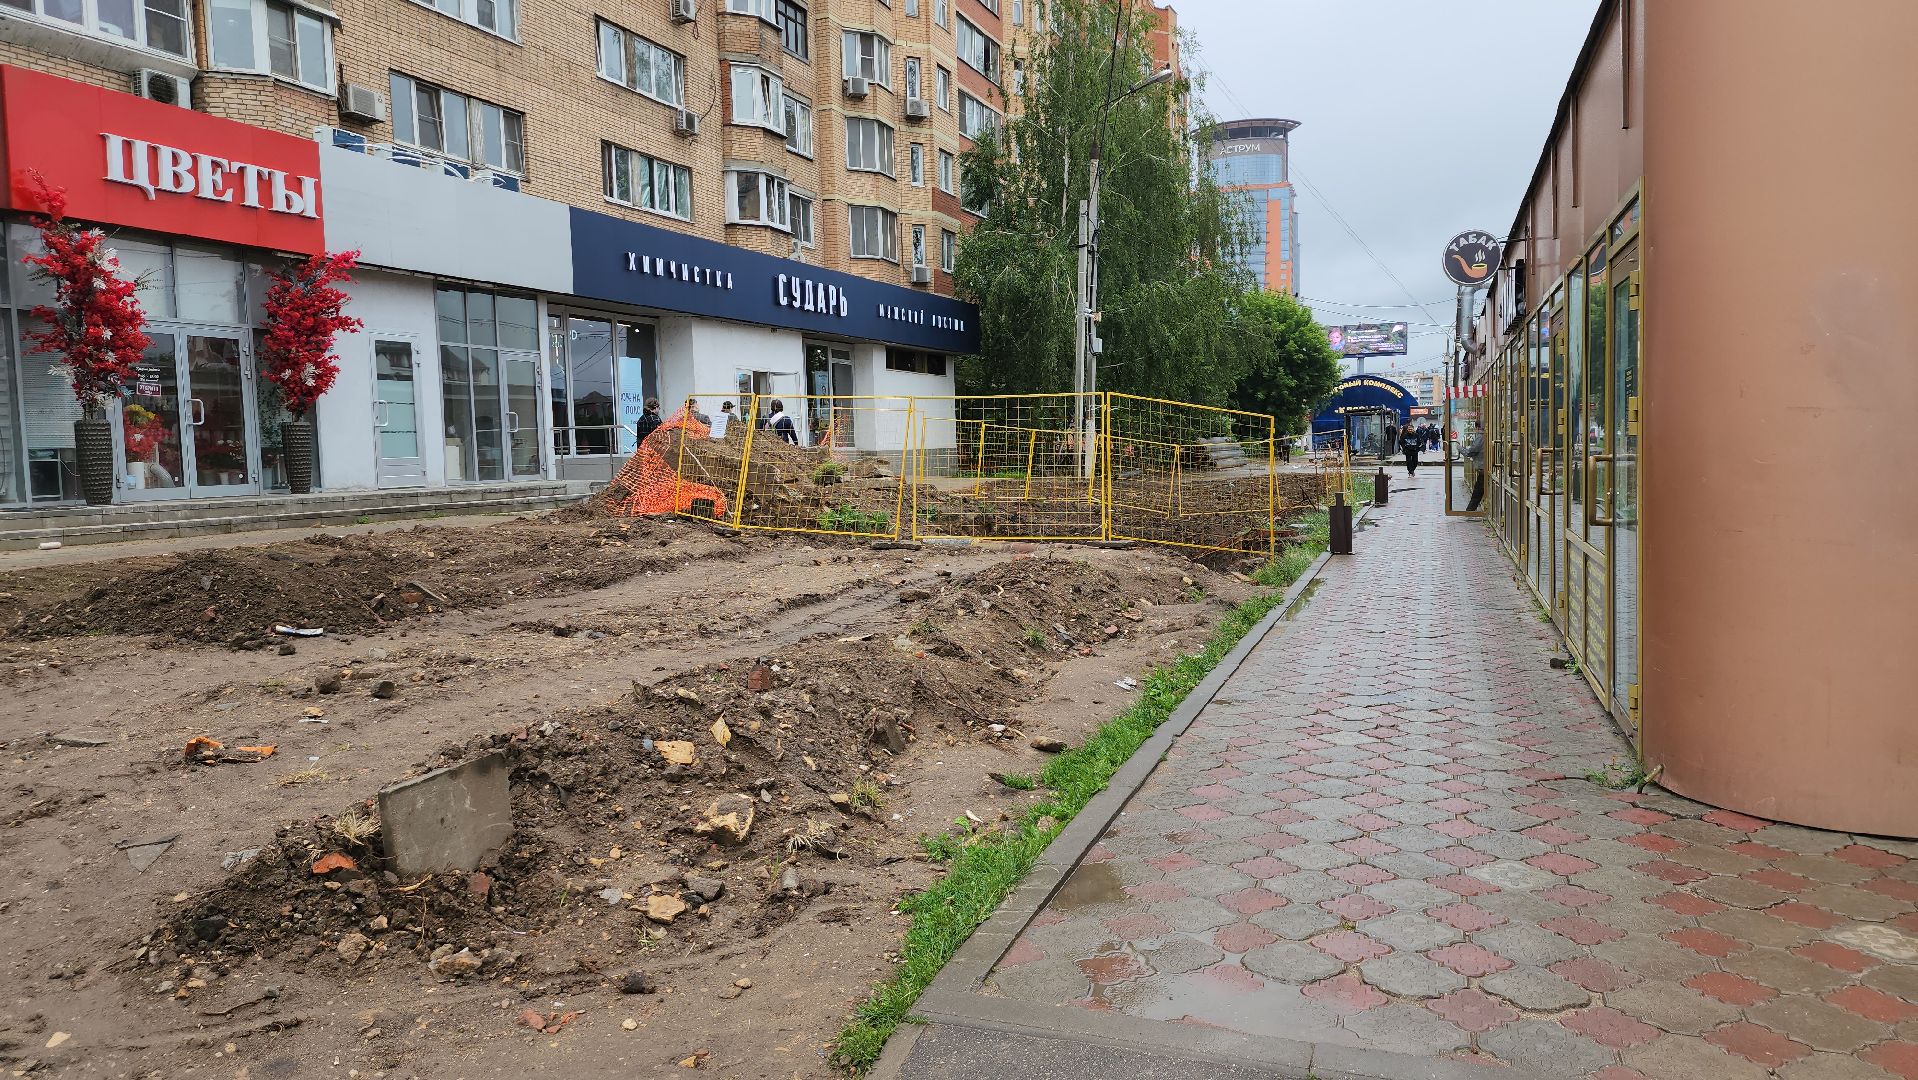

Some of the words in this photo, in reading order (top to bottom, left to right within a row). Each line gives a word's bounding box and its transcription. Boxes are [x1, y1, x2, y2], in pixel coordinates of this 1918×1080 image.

[1219, 143, 1261, 156] АСТРУМ
[100, 133, 320, 218] ЦВЕТЫ
[1449, 233, 1497, 252] ТАБАК
[628, 251, 734, 289] ХИМЧИСТКА
[776, 273, 849, 317] СУДАРЬ
[879, 303, 924, 325] МУЖСКОЙ
[1363, 378, 1404, 399] КОМПЛЕКС
